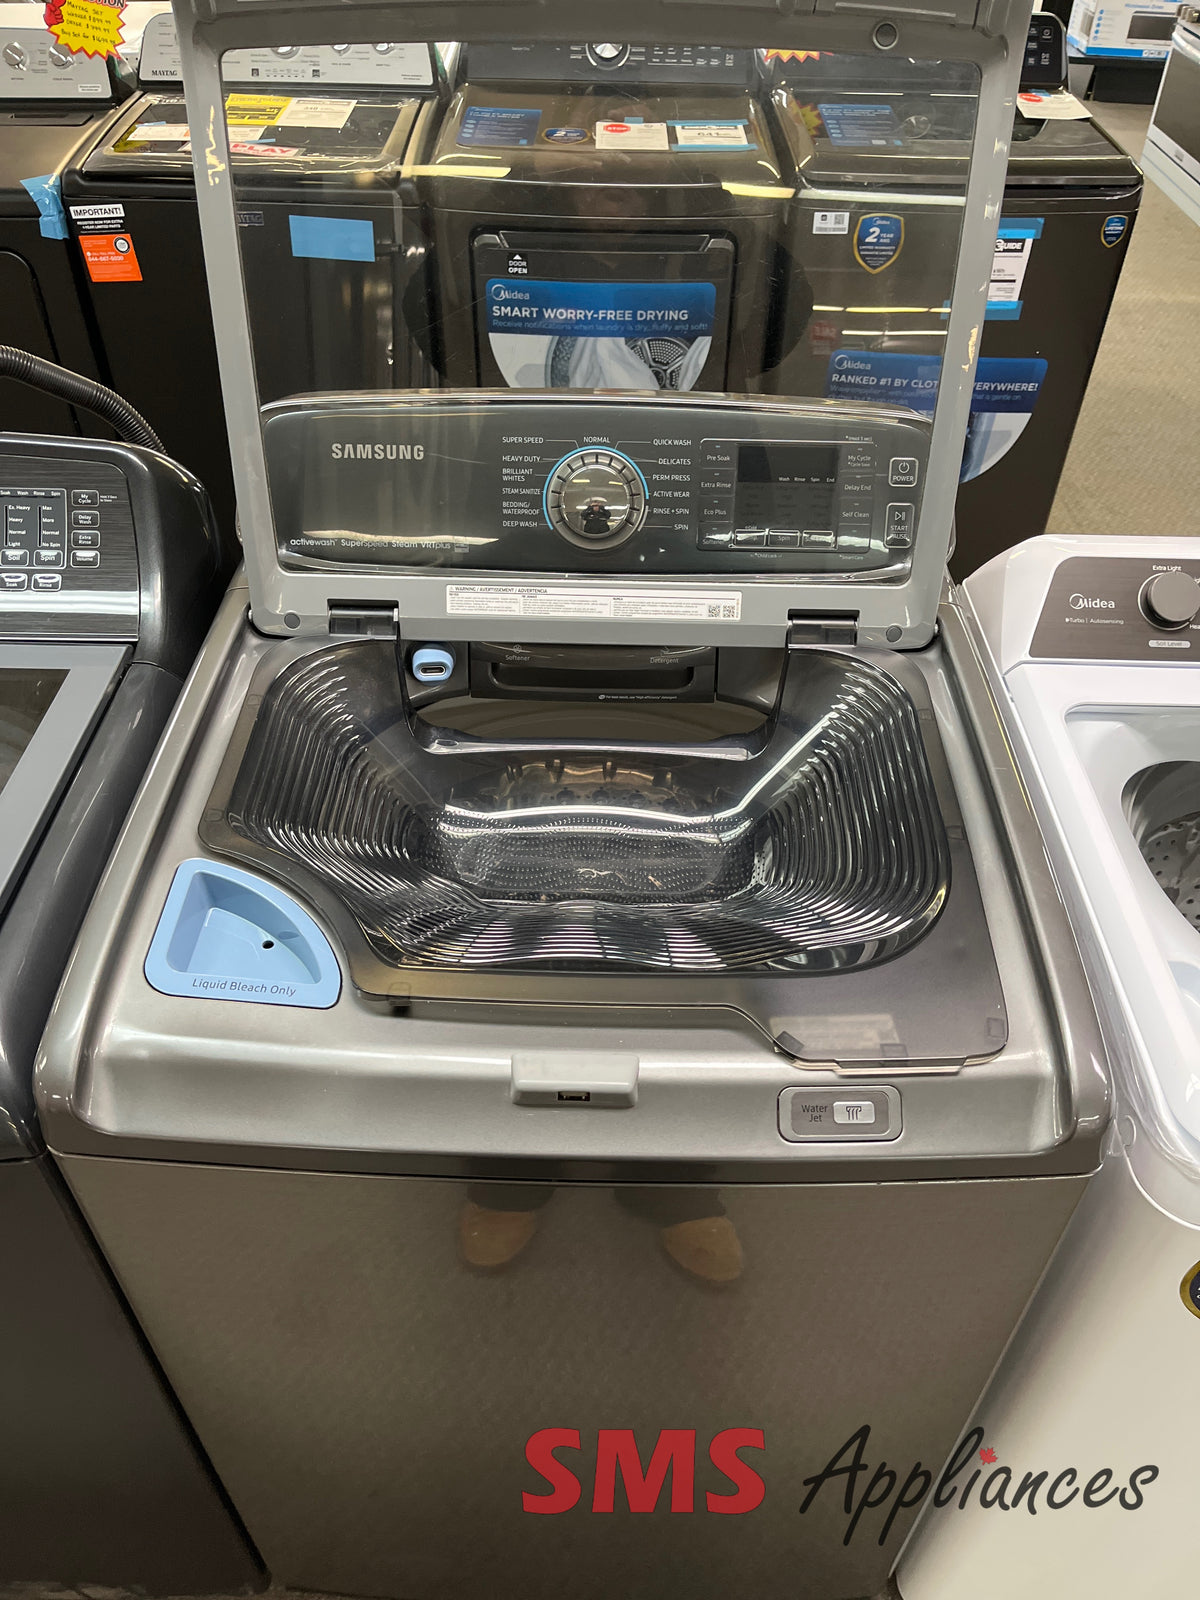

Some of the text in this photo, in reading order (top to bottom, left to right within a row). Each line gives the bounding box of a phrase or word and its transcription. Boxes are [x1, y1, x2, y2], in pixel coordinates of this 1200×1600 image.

[232, 143, 292, 154] PLAY
[73, 208, 122, 216] IMPORTANT!
[865, 227, 880, 242] 2
[492, 284, 530, 301] Midea
[492, 306, 688, 320] SMART WORRY-FREE DRYING
[835, 355, 871, 370] Midea
[832, 374, 877, 384] RANKED
[911, 380, 939, 388] CLOT
[332, 443, 424, 460] SAMSUNG
[340, 539, 388, 547] SuperSpeed
[1069, 593, 1115, 610] Midea
[650, 657, 679, 665] Detergent
[192, 978, 296, 997] Liquid Bleach Only
[801, 1104, 828, 1113] Water
[809, 1114, 822, 1122] Jet
